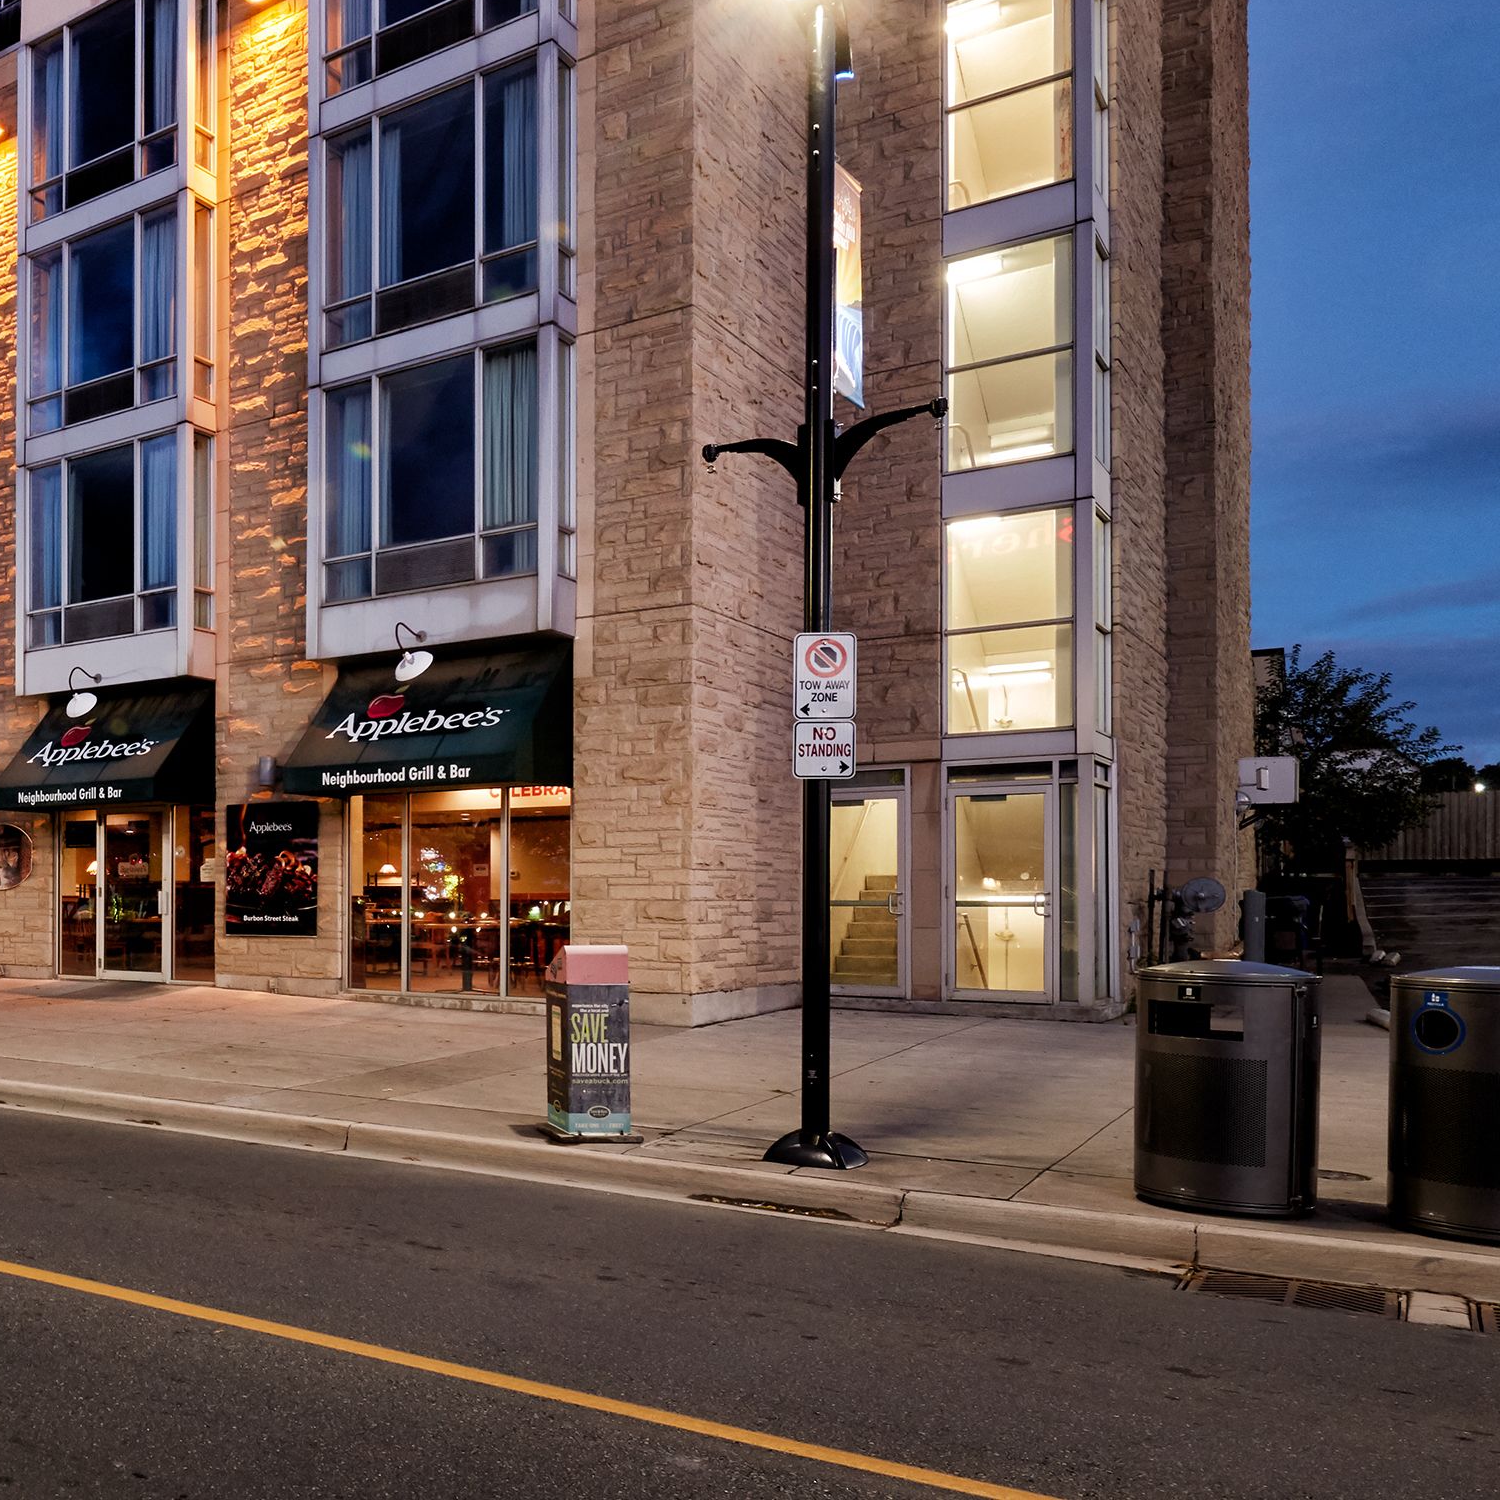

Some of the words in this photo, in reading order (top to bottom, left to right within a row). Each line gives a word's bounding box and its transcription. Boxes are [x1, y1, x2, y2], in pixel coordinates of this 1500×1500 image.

[799, 680, 821, 690] TOW
[825, 680, 850, 690] AWAY
[811, 692, 838, 702] ZONE
[325, 706, 502, 743] Applebee's
[812, 727, 836, 740] NO
[26, 737, 153, 767] Applebee's
[798, 743, 851, 757] STANDING
[322, 768, 405, 788] Neighbourhood
[409, 765, 434, 781] Grill
[437, 765, 446, 779] &
[450, 764, 471, 779] Bar
[18, 789, 77, 806] Neighbourhood
[79, 787, 96, 800] Grill
[98, 787, 105, 799] &
[107, 786, 122, 799] Bar
[490, 786, 567, 798] CLEBRA
[249, 821, 292, 834] Applebee's
[571, 1013, 609, 1043] SAVE
[572, 1043, 628, 1073] MONEY
